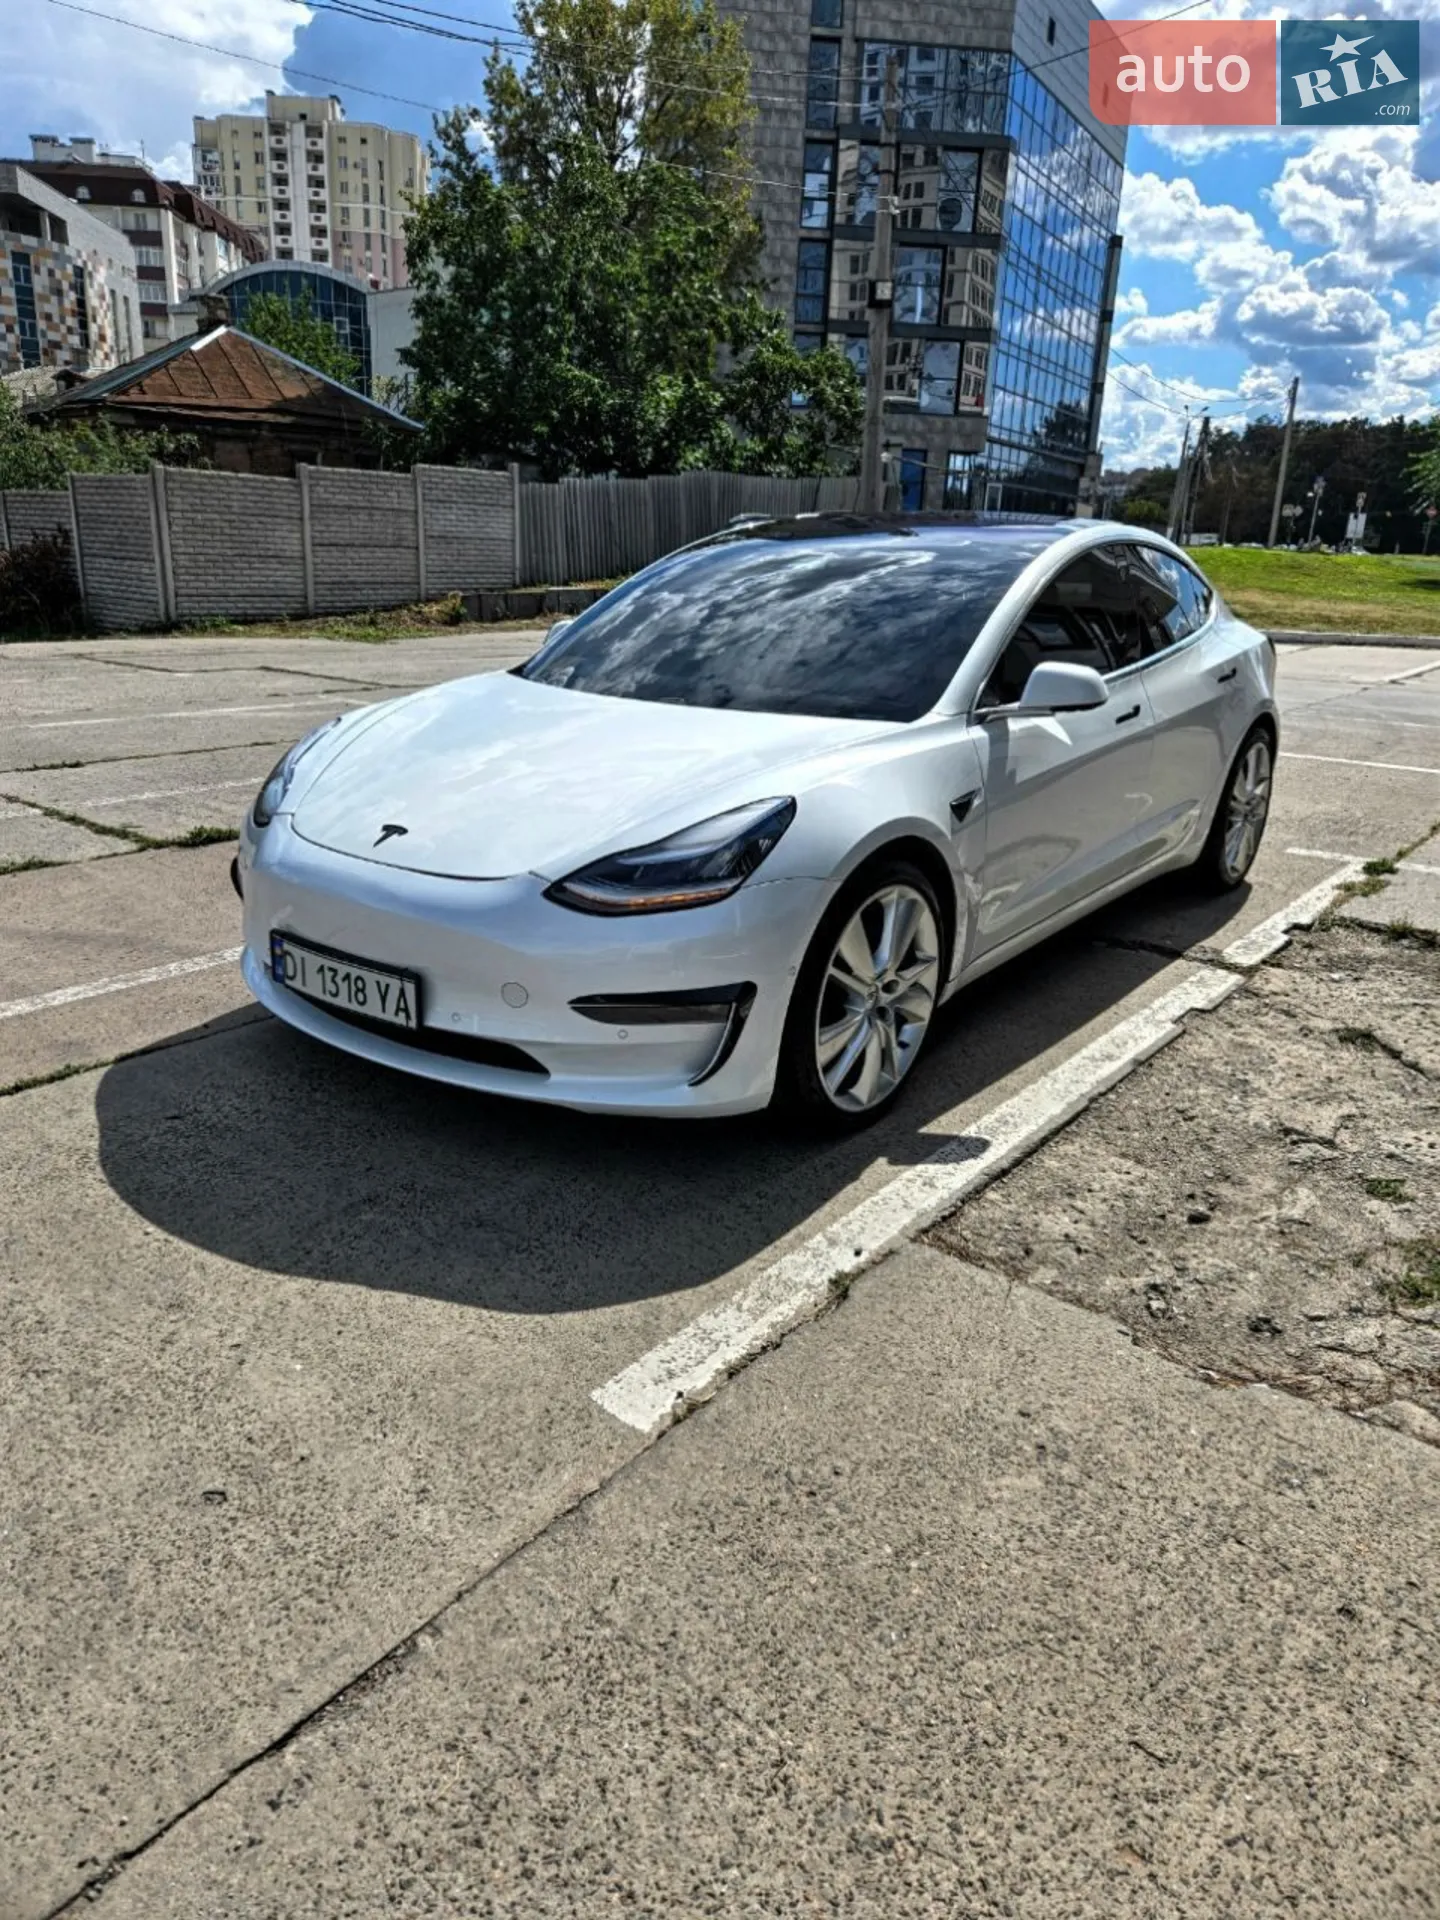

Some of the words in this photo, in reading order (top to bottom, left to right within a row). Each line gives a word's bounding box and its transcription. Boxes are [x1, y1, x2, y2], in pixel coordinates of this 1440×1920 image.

[284, 950, 306, 987] DI
[316, 964, 368, 1006] 1318
[376, 980, 411, 1021] YA
